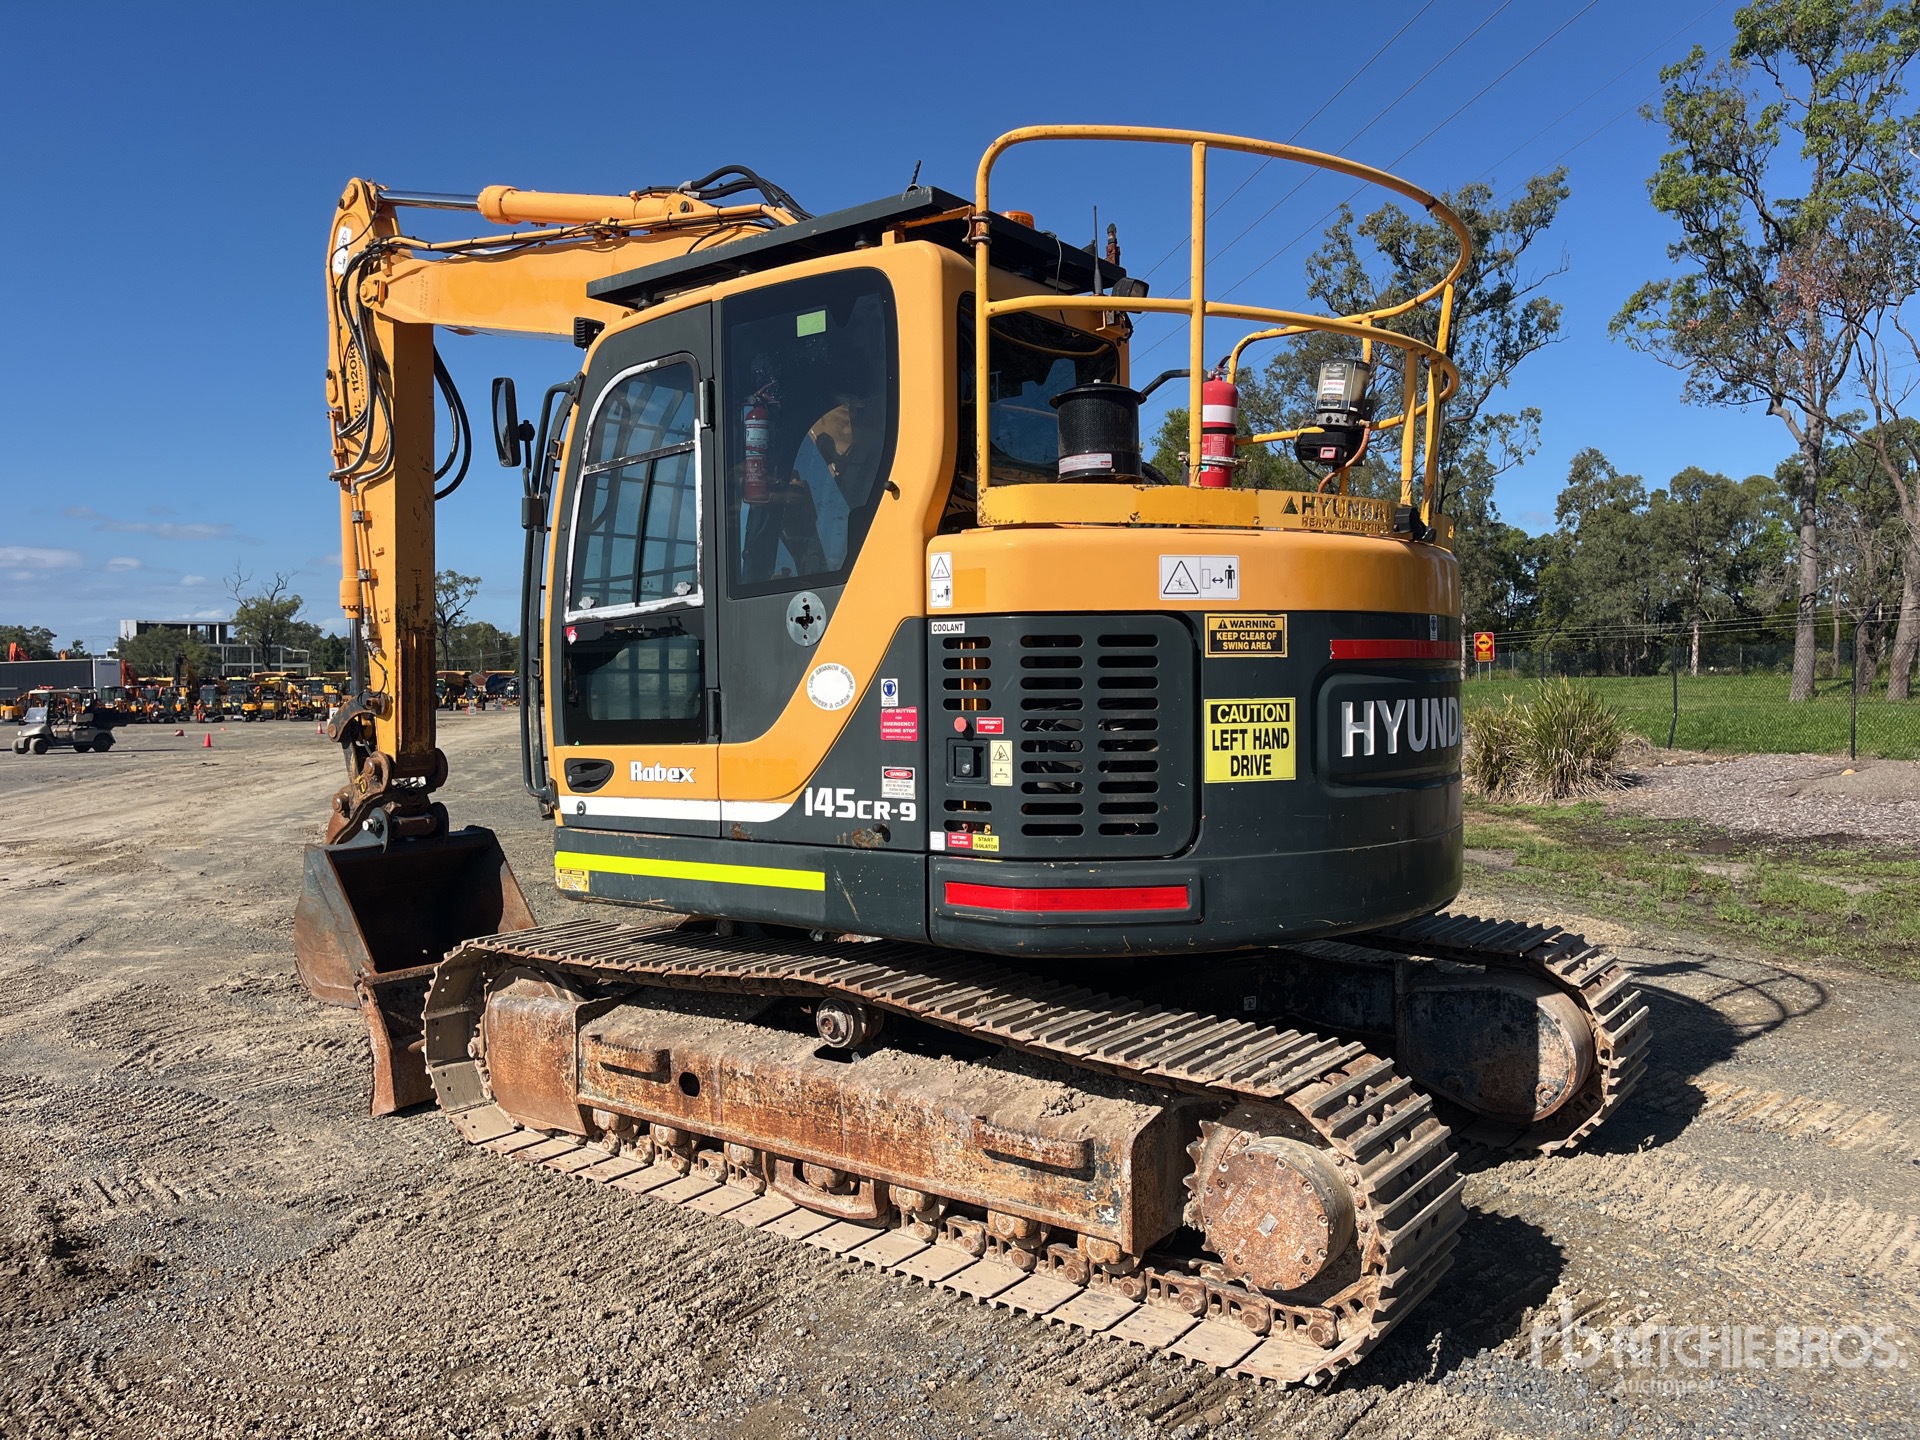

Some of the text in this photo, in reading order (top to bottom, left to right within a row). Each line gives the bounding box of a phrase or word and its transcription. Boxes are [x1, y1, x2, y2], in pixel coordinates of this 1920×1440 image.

[1302, 495, 1391, 525] HYUNDAI
[1302, 517, 1335, 529] HEAVY
[933, 623, 963, 632] COOLANT
[1230, 620, 1276, 629] WARNING
[1216, 631, 1277, 641] KEEP CLEAR OF
[1222, 641, 1272, 650] SWING AREA
[1217, 704, 1287, 723] CAUTION
[1341, 696, 1461, 757] HYUND
[1212, 727, 1290, 751] LEFT HAND
[629, 760, 696, 784] Robex
[1230, 754, 1272, 777] DRIVE
[804, 787, 917, 822] 145CR-9
